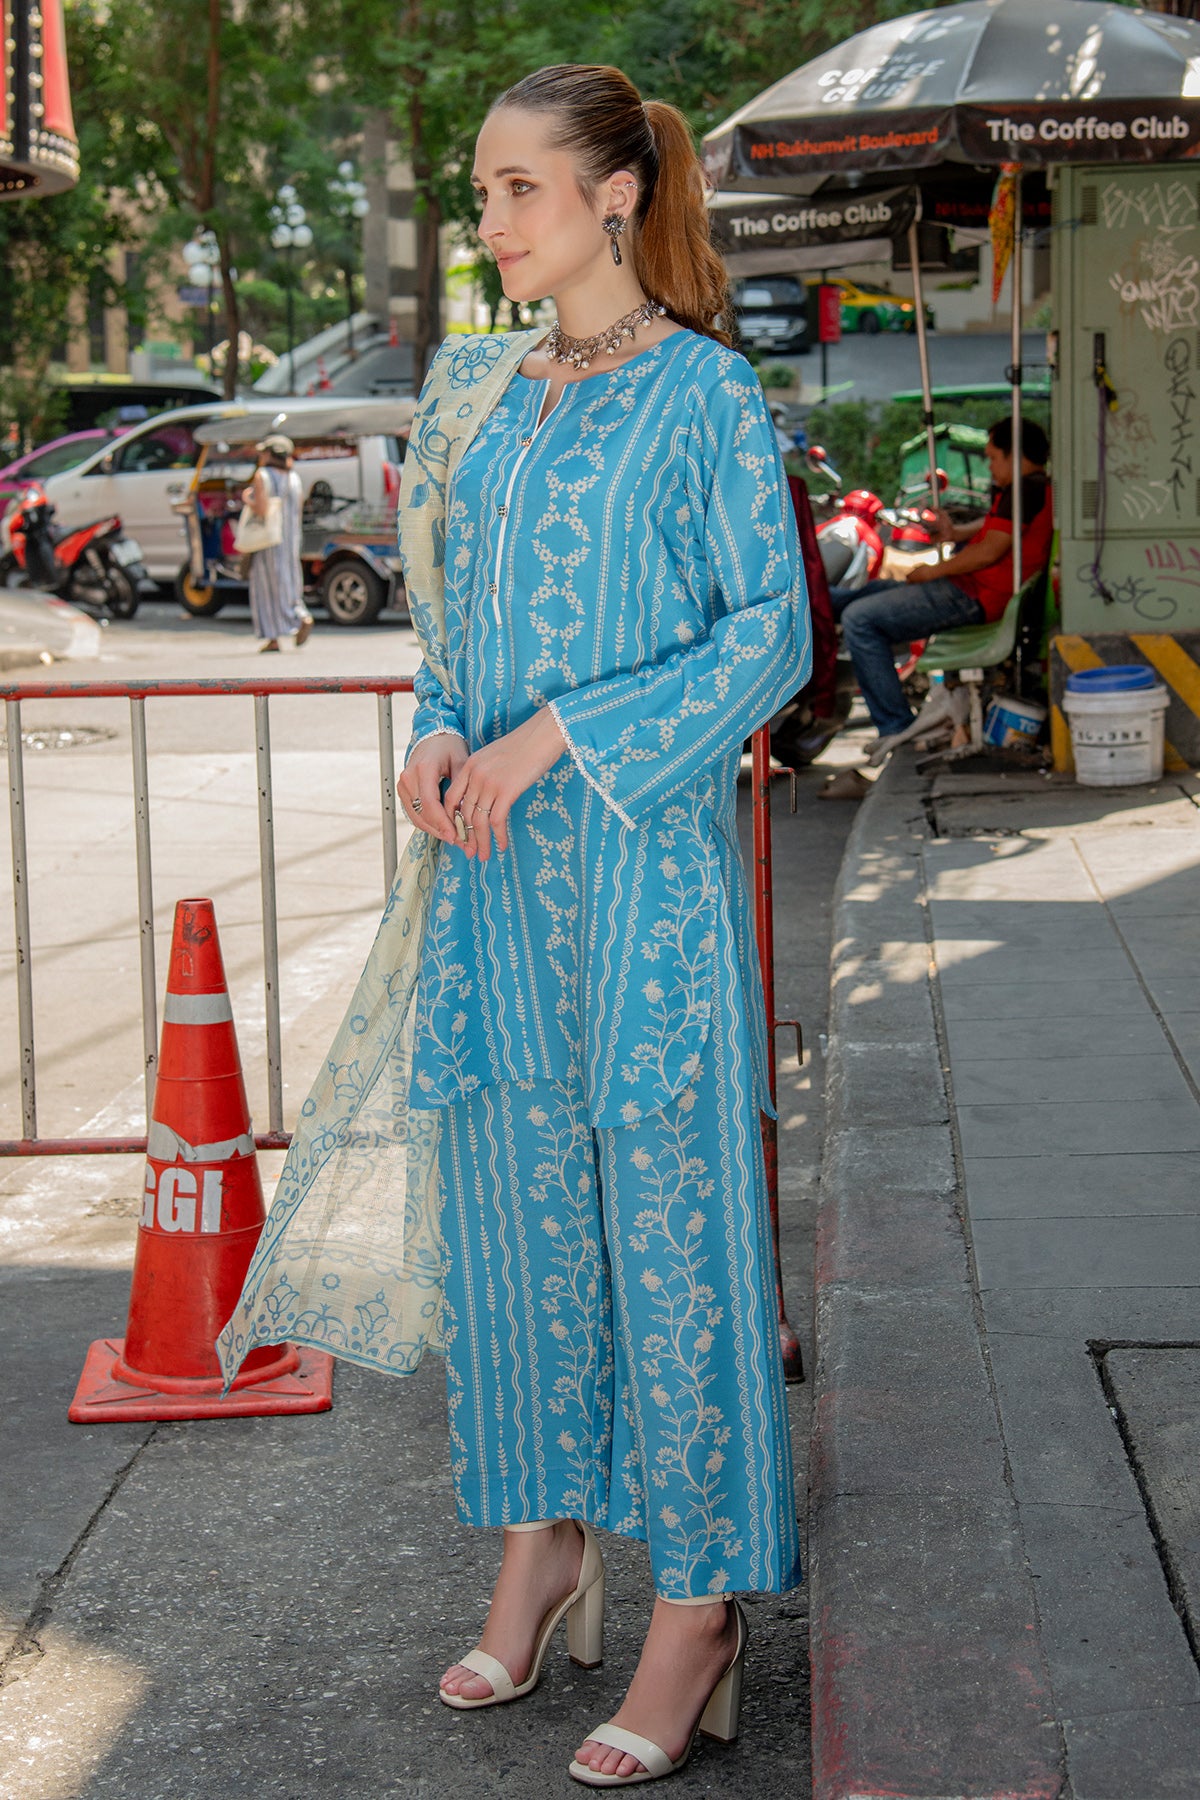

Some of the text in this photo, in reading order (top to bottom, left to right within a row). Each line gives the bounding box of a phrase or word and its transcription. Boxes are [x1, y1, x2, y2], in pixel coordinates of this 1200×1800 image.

[817, 59, 945, 87] COFFEE
[821, 81, 908, 104] CLUB
[986, 115, 1190, 142] The Coffee Club
[750, 143, 774, 160] NH
[776, 135, 857, 158] Sukhumvit
[859, 126, 939, 151] Boulevard
[730, 201, 892, 237] The Coffee Club
